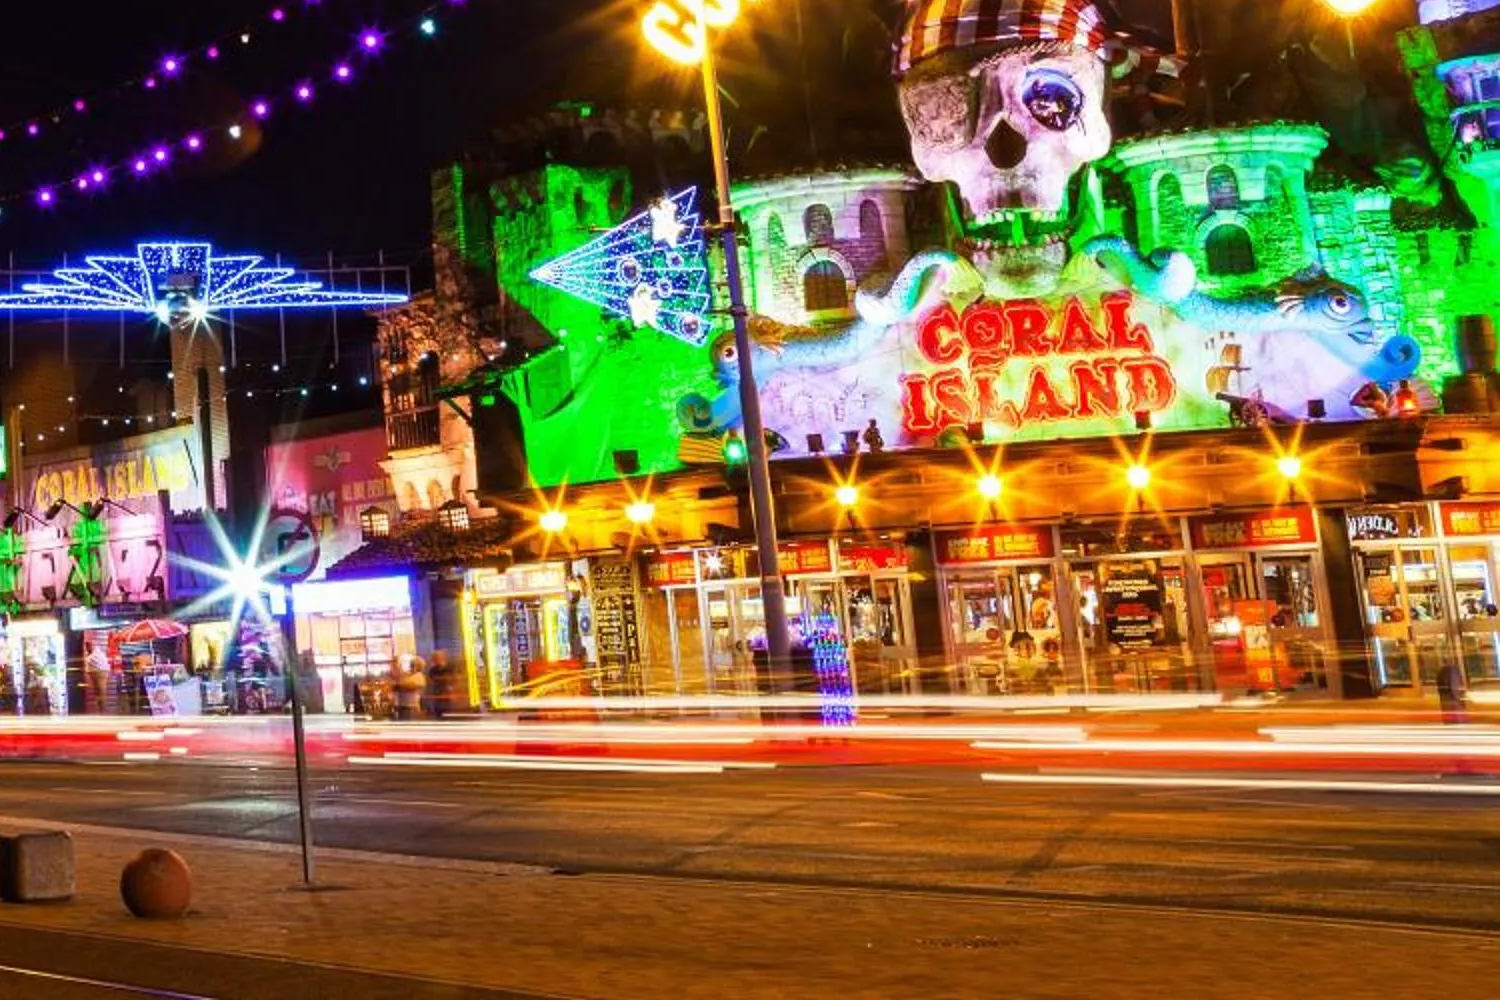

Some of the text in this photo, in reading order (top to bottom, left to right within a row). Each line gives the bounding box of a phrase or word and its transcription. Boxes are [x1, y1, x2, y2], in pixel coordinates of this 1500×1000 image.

[915, 291, 1156, 366] CORAL
[900, 356, 1178, 434] ISLAND
[35, 452, 188, 512] CORAL ISLAND
